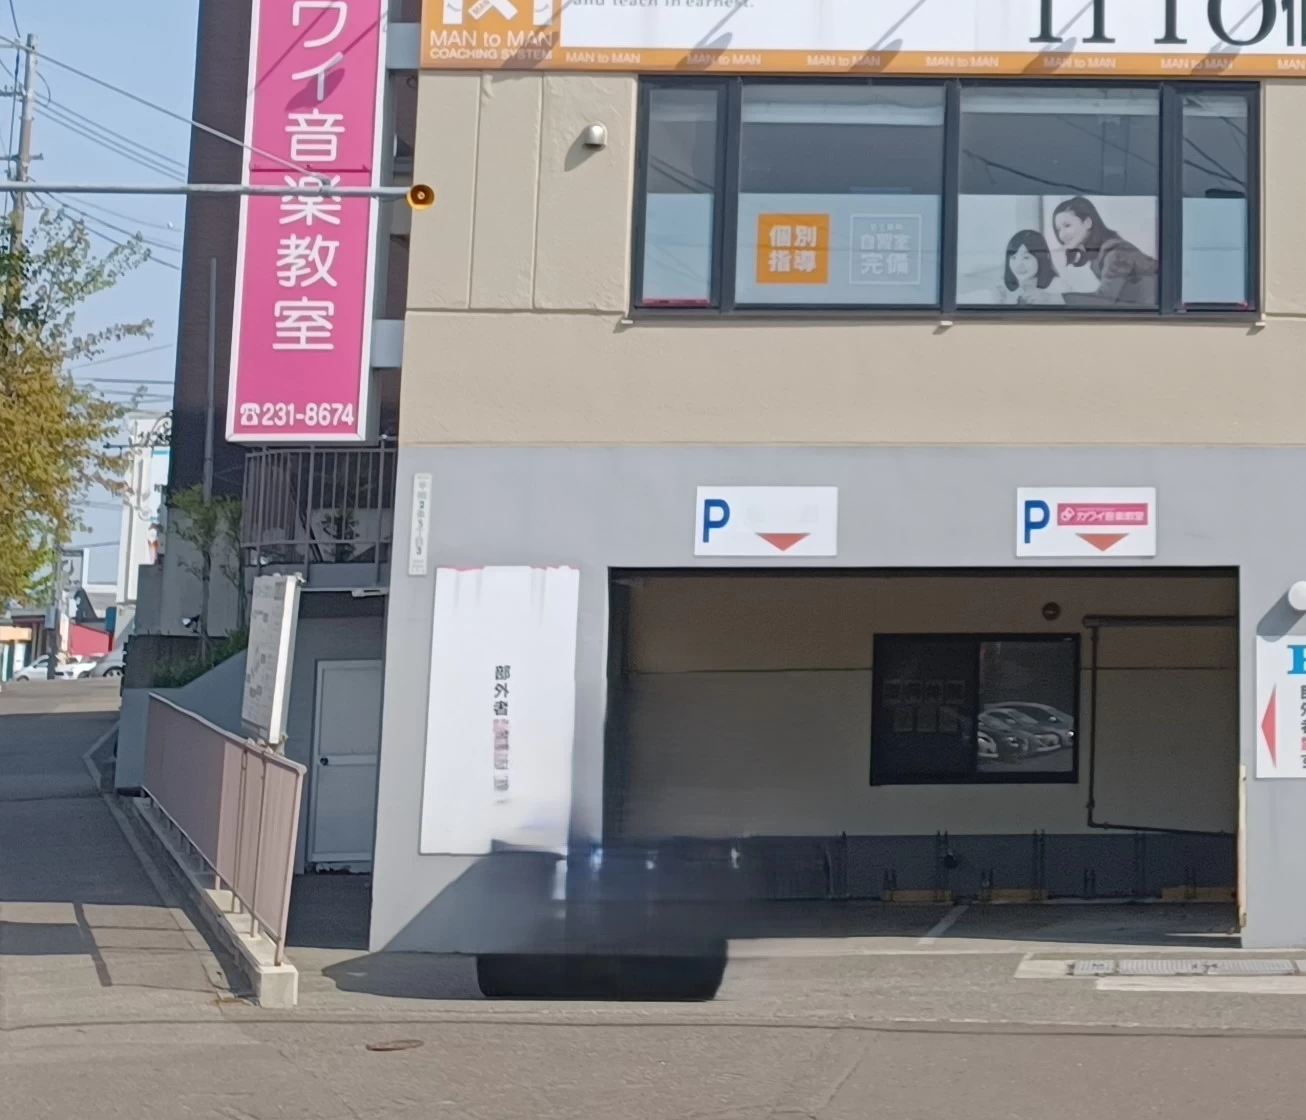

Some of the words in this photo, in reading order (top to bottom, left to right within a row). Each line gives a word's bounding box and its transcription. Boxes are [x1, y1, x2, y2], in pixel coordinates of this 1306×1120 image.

[430, 30, 476, 46] MAN
[483, 31, 501, 47] to
[507, 30, 552, 47] MAN
[430, 48, 498, 59] COACHING
[501, 48, 552, 60] SYSTEM
[566, 52, 595, 64] MAN
[612, 52, 640, 64] MAN
[687, 54, 715, 65] MAN
[733, 54, 761, 65] MAN
[807, 55, 835, 66] MAN
[852, 55, 880, 66] MAN
[926, 56, 955, 67] MAN
[971, 56, 998, 67] MAN
[1044, 57, 1072, 68] MAN
[1088, 57, 1116, 68] MAN
[1161, 58, 1188, 69] MAN
[1205, 58, 1233, 69] MAN
[1278, 59, 1305, 70] MAN
[769, 225, 817, 247] 個別
[768, 249, 817, 272] 指導
[262, 402, 354, 426] 231-8674
[703, 499, 731, 543] P
[1024, 500, 1050, 544] P
